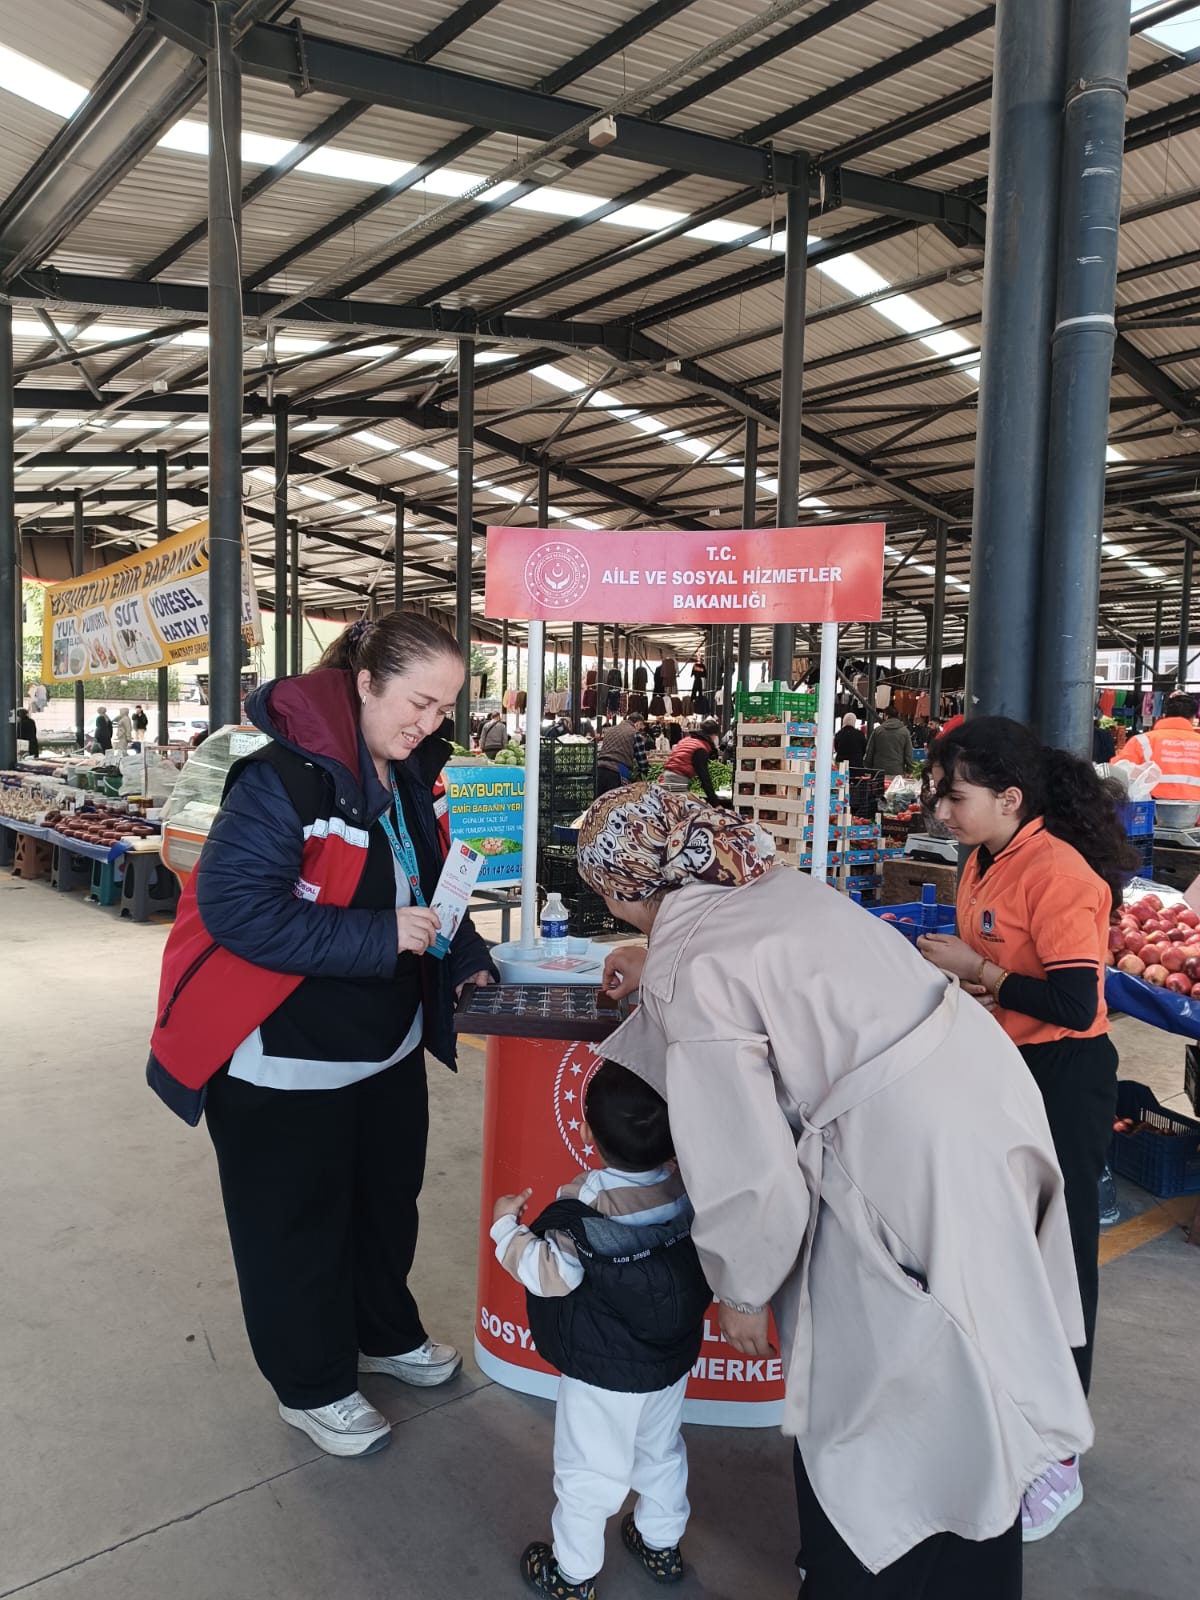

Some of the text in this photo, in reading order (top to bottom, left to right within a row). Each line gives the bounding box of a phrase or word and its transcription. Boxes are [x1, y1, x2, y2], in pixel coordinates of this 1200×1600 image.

[706, 546, 736, 561] T.C.
[601, 567, 842, 585] AİLE VE SOSYAL HİZMETLER
[673, 590, 767, 609] BAKANLIĞI
[160, 617, 200, 642] HATAY
[450, 782, 526, 798] BAYBURTLU
[481, 1306, 536, 1352] SOSY
[691, 1357, 784, 1382] MERKE
